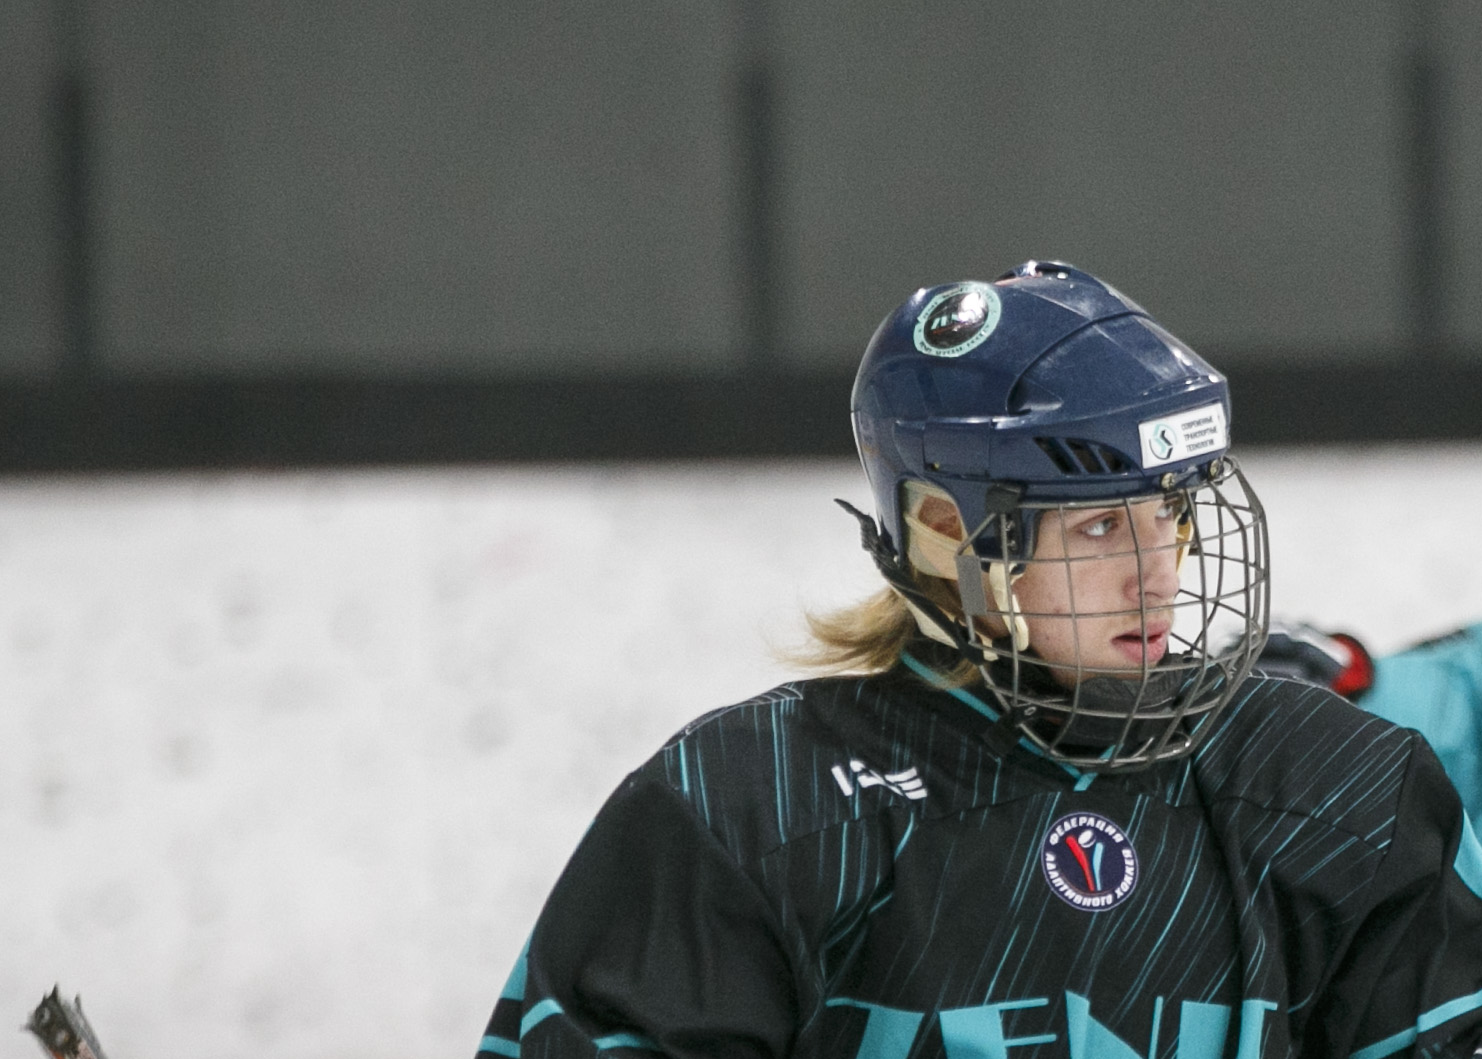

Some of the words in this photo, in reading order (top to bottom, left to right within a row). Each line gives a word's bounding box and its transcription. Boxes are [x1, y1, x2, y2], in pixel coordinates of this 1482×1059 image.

[1049, 815, 1125, 846] ФЕДЕРАЦИЯ
[1045, 852, 1114, 908] АДАПТИВНОГО
[1114, 848, 1135, 900] ХОККЕЯ
